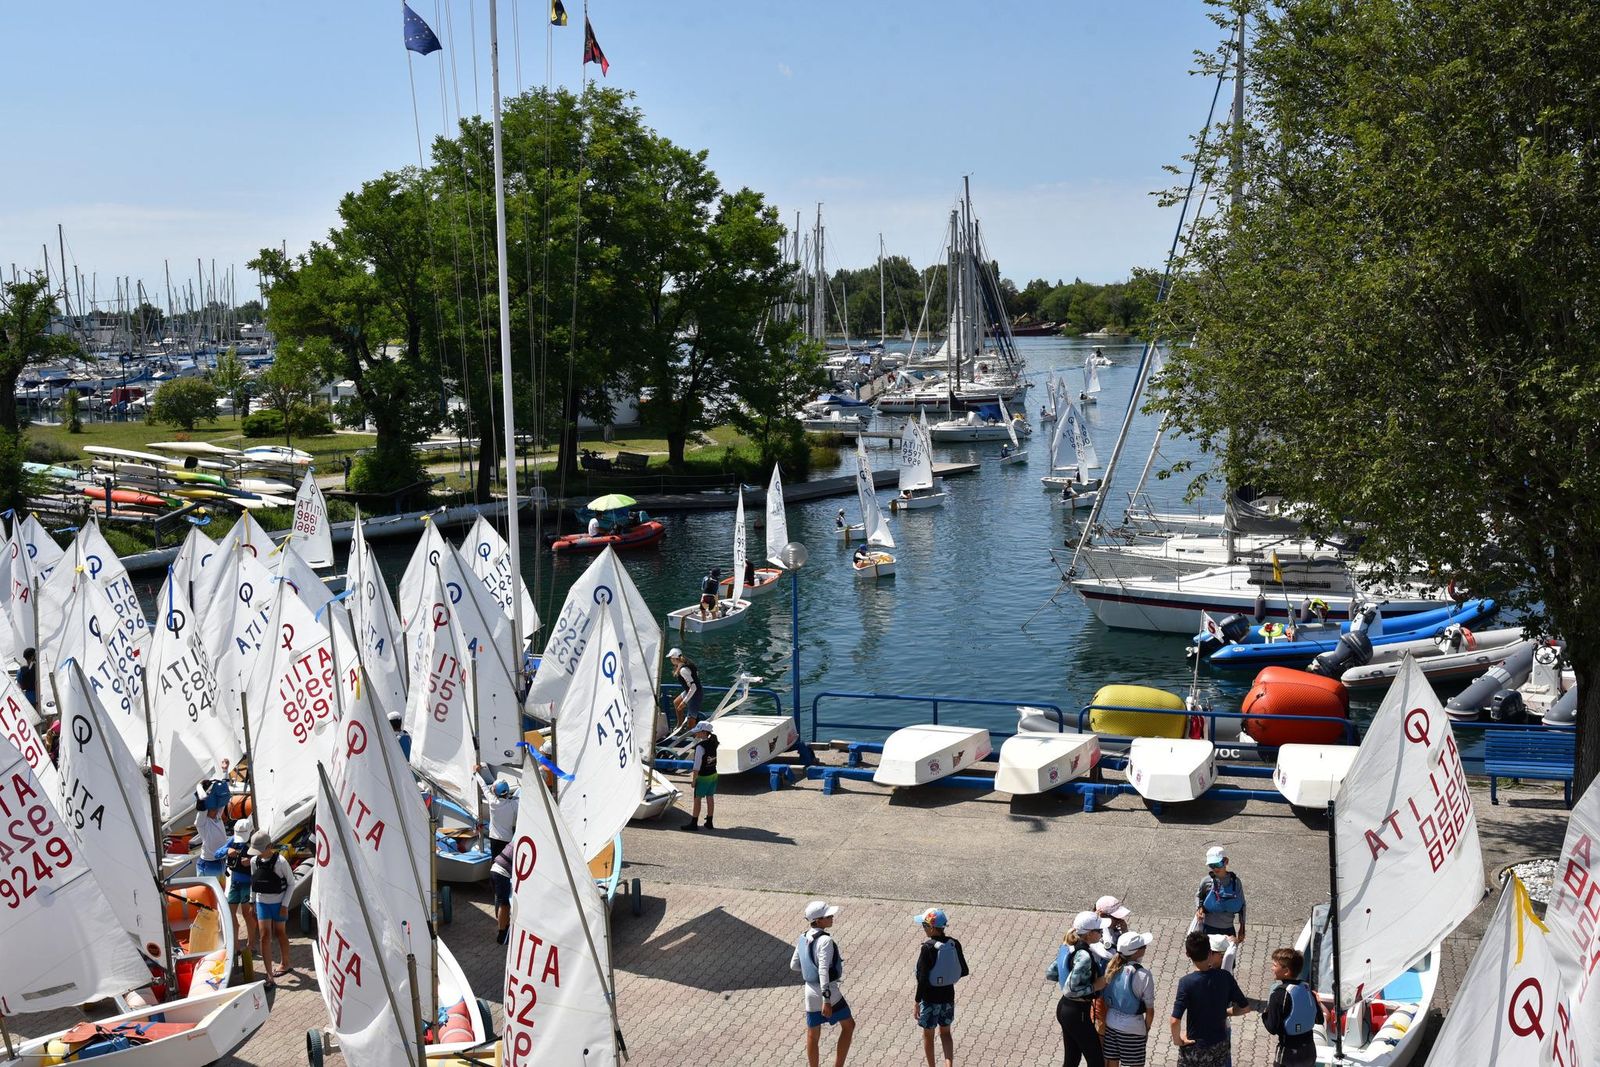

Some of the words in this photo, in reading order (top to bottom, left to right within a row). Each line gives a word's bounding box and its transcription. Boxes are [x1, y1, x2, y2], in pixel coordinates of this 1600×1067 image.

[902, 448, 922, 458] 9597
[297, 510, 318, 525] 9861
[105, 577, 132, 603] ITA
[292, 646, 332, 682] ITA
[1430, 735, 1456, 797] ITA
[72, 778, 105, 831] ITA
[346, 792, 386, 852] ITA
[1428, 786, 1471, 874] 8960
[0, 836, 73, 909] 9249
[326, 920, 362, 988] ITA
[516, 930, 560, 988] ITA
